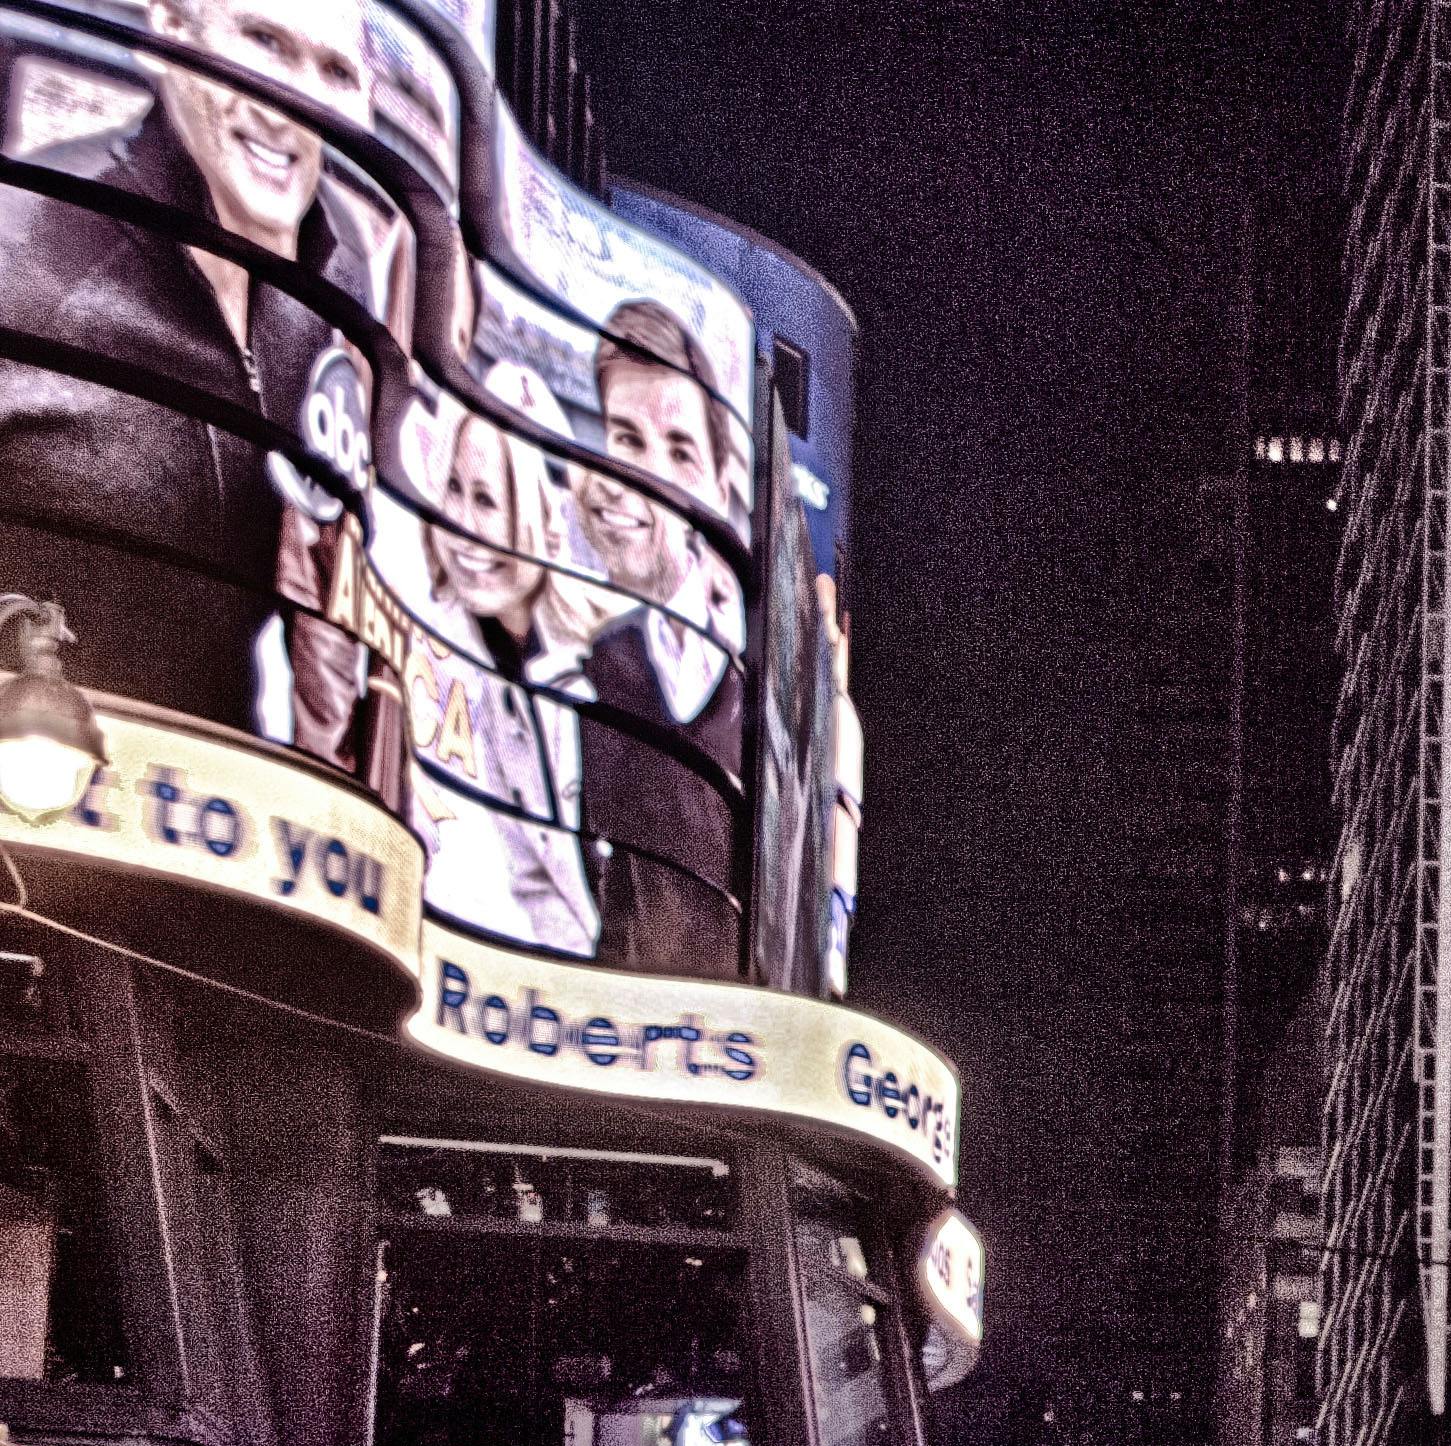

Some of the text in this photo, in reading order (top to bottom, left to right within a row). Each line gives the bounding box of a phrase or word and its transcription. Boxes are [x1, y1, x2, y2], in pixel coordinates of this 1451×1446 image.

[307, 391, 371, 490] abc
[138, 758, 247, 860] to
[273, 812, 386, 913] you
[437, 958, 760, 1083] Roberts
